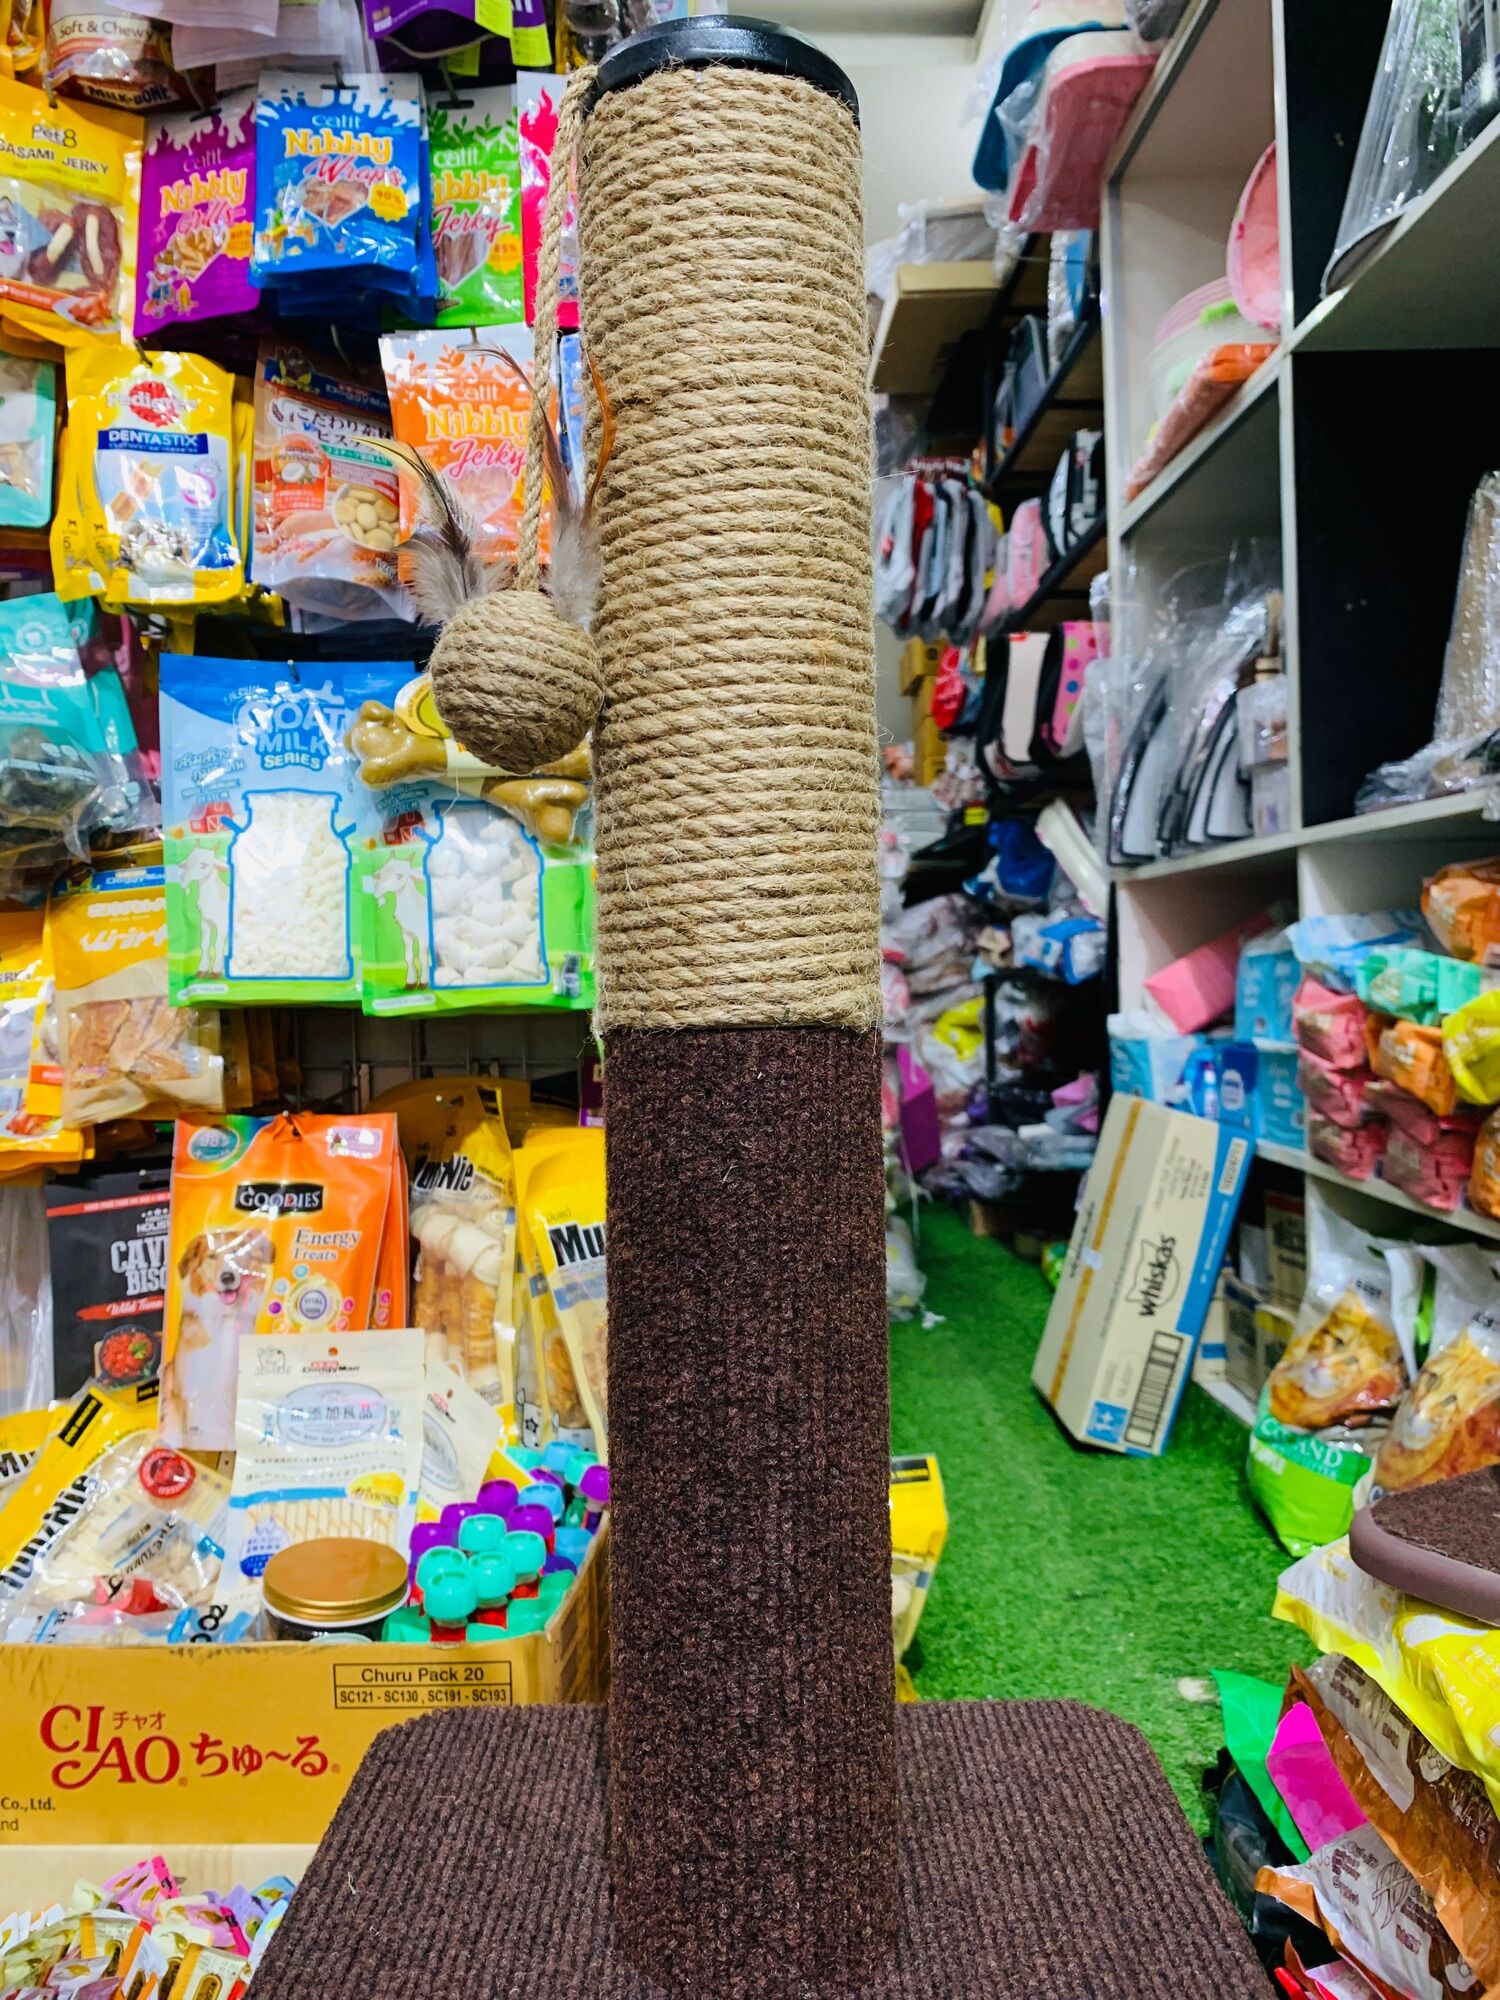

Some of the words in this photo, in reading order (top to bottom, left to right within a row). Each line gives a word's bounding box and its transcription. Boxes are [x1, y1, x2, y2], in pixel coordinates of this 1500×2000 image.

[87, 20, 97, 33] &
[281, 127, 394, 165] Nibbly
[62, 157, 109, 174] JERKY
[160, 166, 248, 219] Nibbly
[431, 170, 512, 216] ibbly
[432, 205, 514, 247] Jerky
[109, 430, 198, 447] DENTASTIX
[449, 438, 528, 479] Jerky
[257, 731, 328, 758] MILK
[263, 751, 321, 770] SERIES
[239, 1187, 321, 1209] GOODIES
[295, 1228, 360, 1249] Energy
[294, 1247, 337, 1261] Treats
[1138, 1234, 1177, 1317] whiskas
[361, 1667, 413, 1683] Churu
[418, 1666, 458, 1682] Pack
[463, 1666, 485, 1682] 20
[340, 1690, 373, 1704] SC121
[384, 1690, 418, 1703] SC130
[427, 1689, 462, 1703] SC191
[471, 1687, 507, 1702] SC193
[112, 1711, 166, 1731] チャオ
[40, 1704, 181, 1790] CIAO
